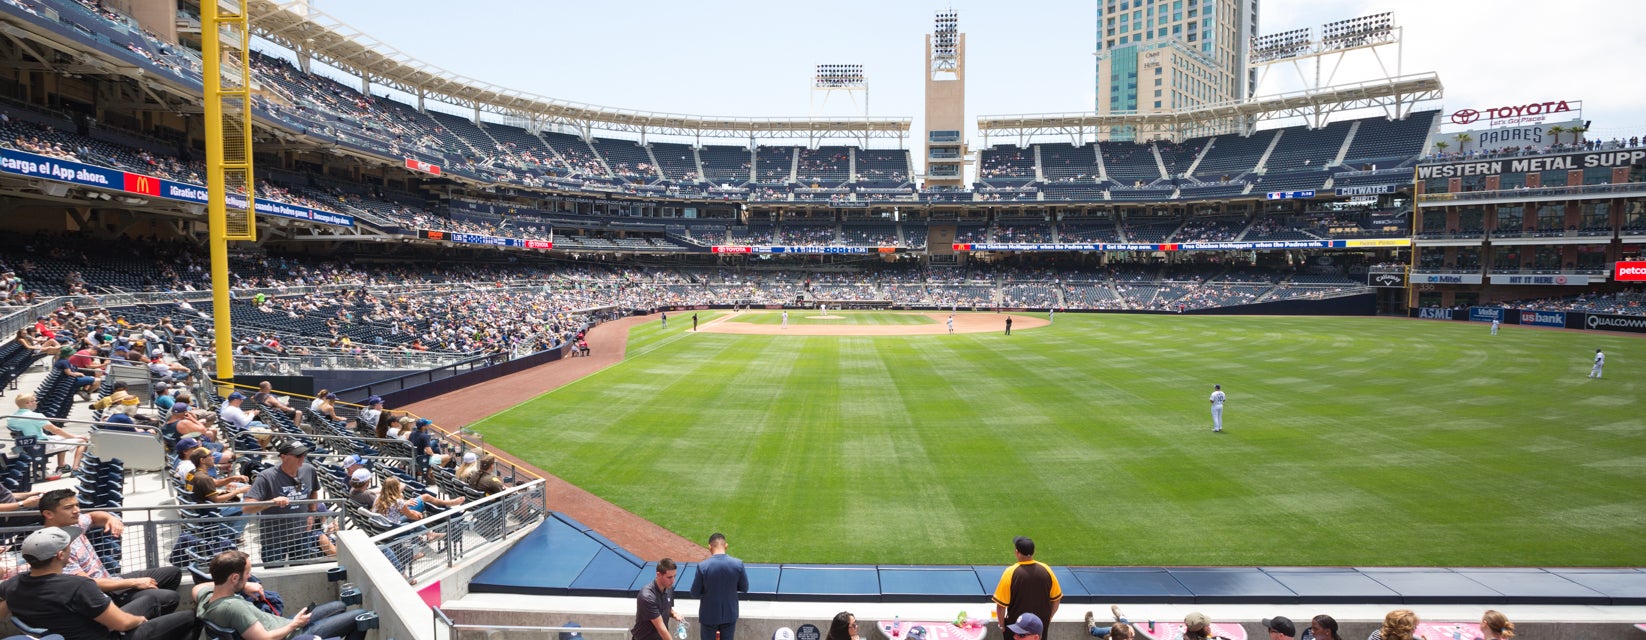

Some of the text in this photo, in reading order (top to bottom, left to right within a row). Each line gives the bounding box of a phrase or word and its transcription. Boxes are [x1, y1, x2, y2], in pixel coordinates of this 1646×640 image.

[1486, 100, 1571, 120] TOYOTA
[1479, 127, 1543, 147] PADRES
[0, 157, 109, 184] carga el App ahora.
[1418, 150, 1646, 179] WESTERN METAL SUPP
[1341, 185, 1388, 197] CUTWATER
[1440, 275, 1462, 283] Mitel
[1510, 276, 1554, 284] HIT IT HERE
[1420, 308, 1452, 320] ASML
[18, 438, 34, 446] 127
